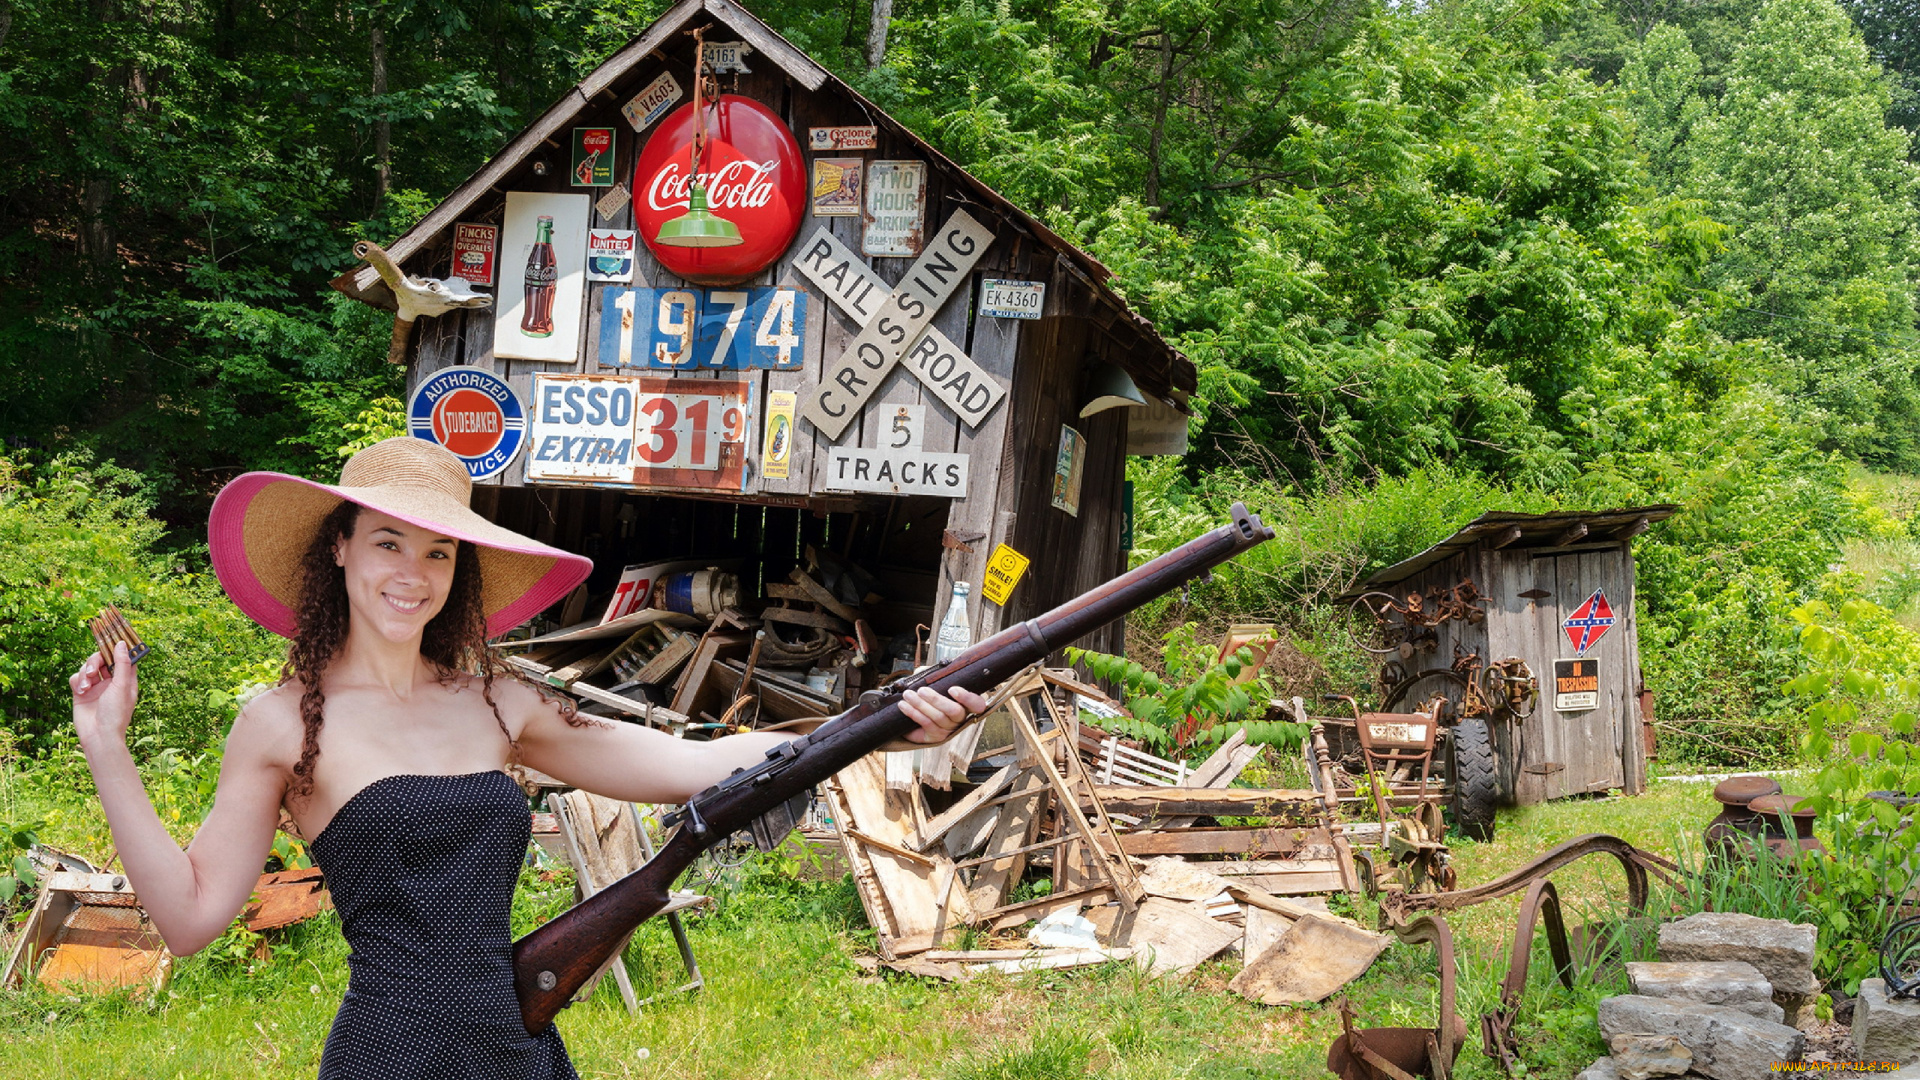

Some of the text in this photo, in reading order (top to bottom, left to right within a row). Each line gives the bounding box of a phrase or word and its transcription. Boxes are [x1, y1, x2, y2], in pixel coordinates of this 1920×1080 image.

[640, 80, 675, 112] V4603
[830, 129, 871, 143] Cyclone
[840, 137, 871, 148] Fence
[648, 160, 780, 211] Coca-Cola
[881, 171, 913, 189] TWO
[874, 194, 917, 211] HOUR
[459, 226, 493, 240] FINCK'S
[867, 216, 919, 231] ARKIN
[457, 243, 492, 252] OVERALLS
[593, 239, 629, 249] UNITED
[615, 290, 799, 364] 1974
[803, 238, 991, 414] RAIL ROAD
[818, 229, 976, 418] CROSSING
[425, 373, 509, 402] AUTHORIZED
[542, 385, 632, 427] ESSO
[890, 415, 911, 448] 5
[535, 435, 632, 465] EXTRA
[721, 445, 736, 455] TAX
[836, 456, 960, 487] TRACKS
[989, 565, 1013, 585] SMILE!
[1572, 661, 1582, 676] NO
[1556, 676, 1598, 692] TRESPASSING
